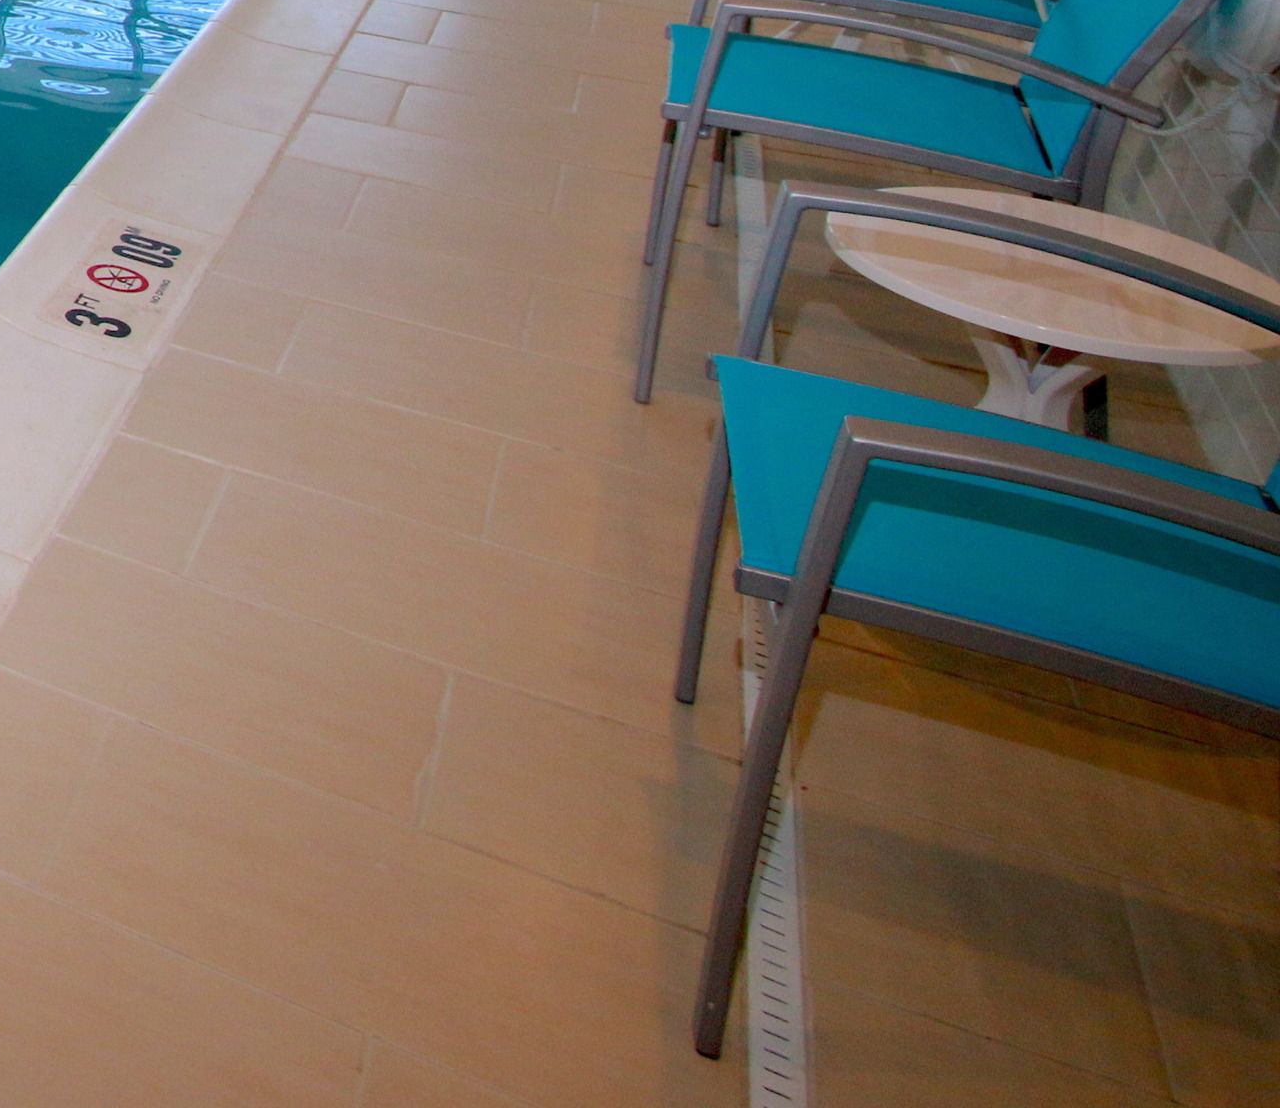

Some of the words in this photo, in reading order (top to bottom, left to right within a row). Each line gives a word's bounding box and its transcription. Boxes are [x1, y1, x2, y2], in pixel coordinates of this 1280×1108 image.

[74, 293, 100, 310] FT
[149, 294, 160, 304] NO
[157, 279, 171, 297] DIVING
[65, 308, 132, 338] 3
